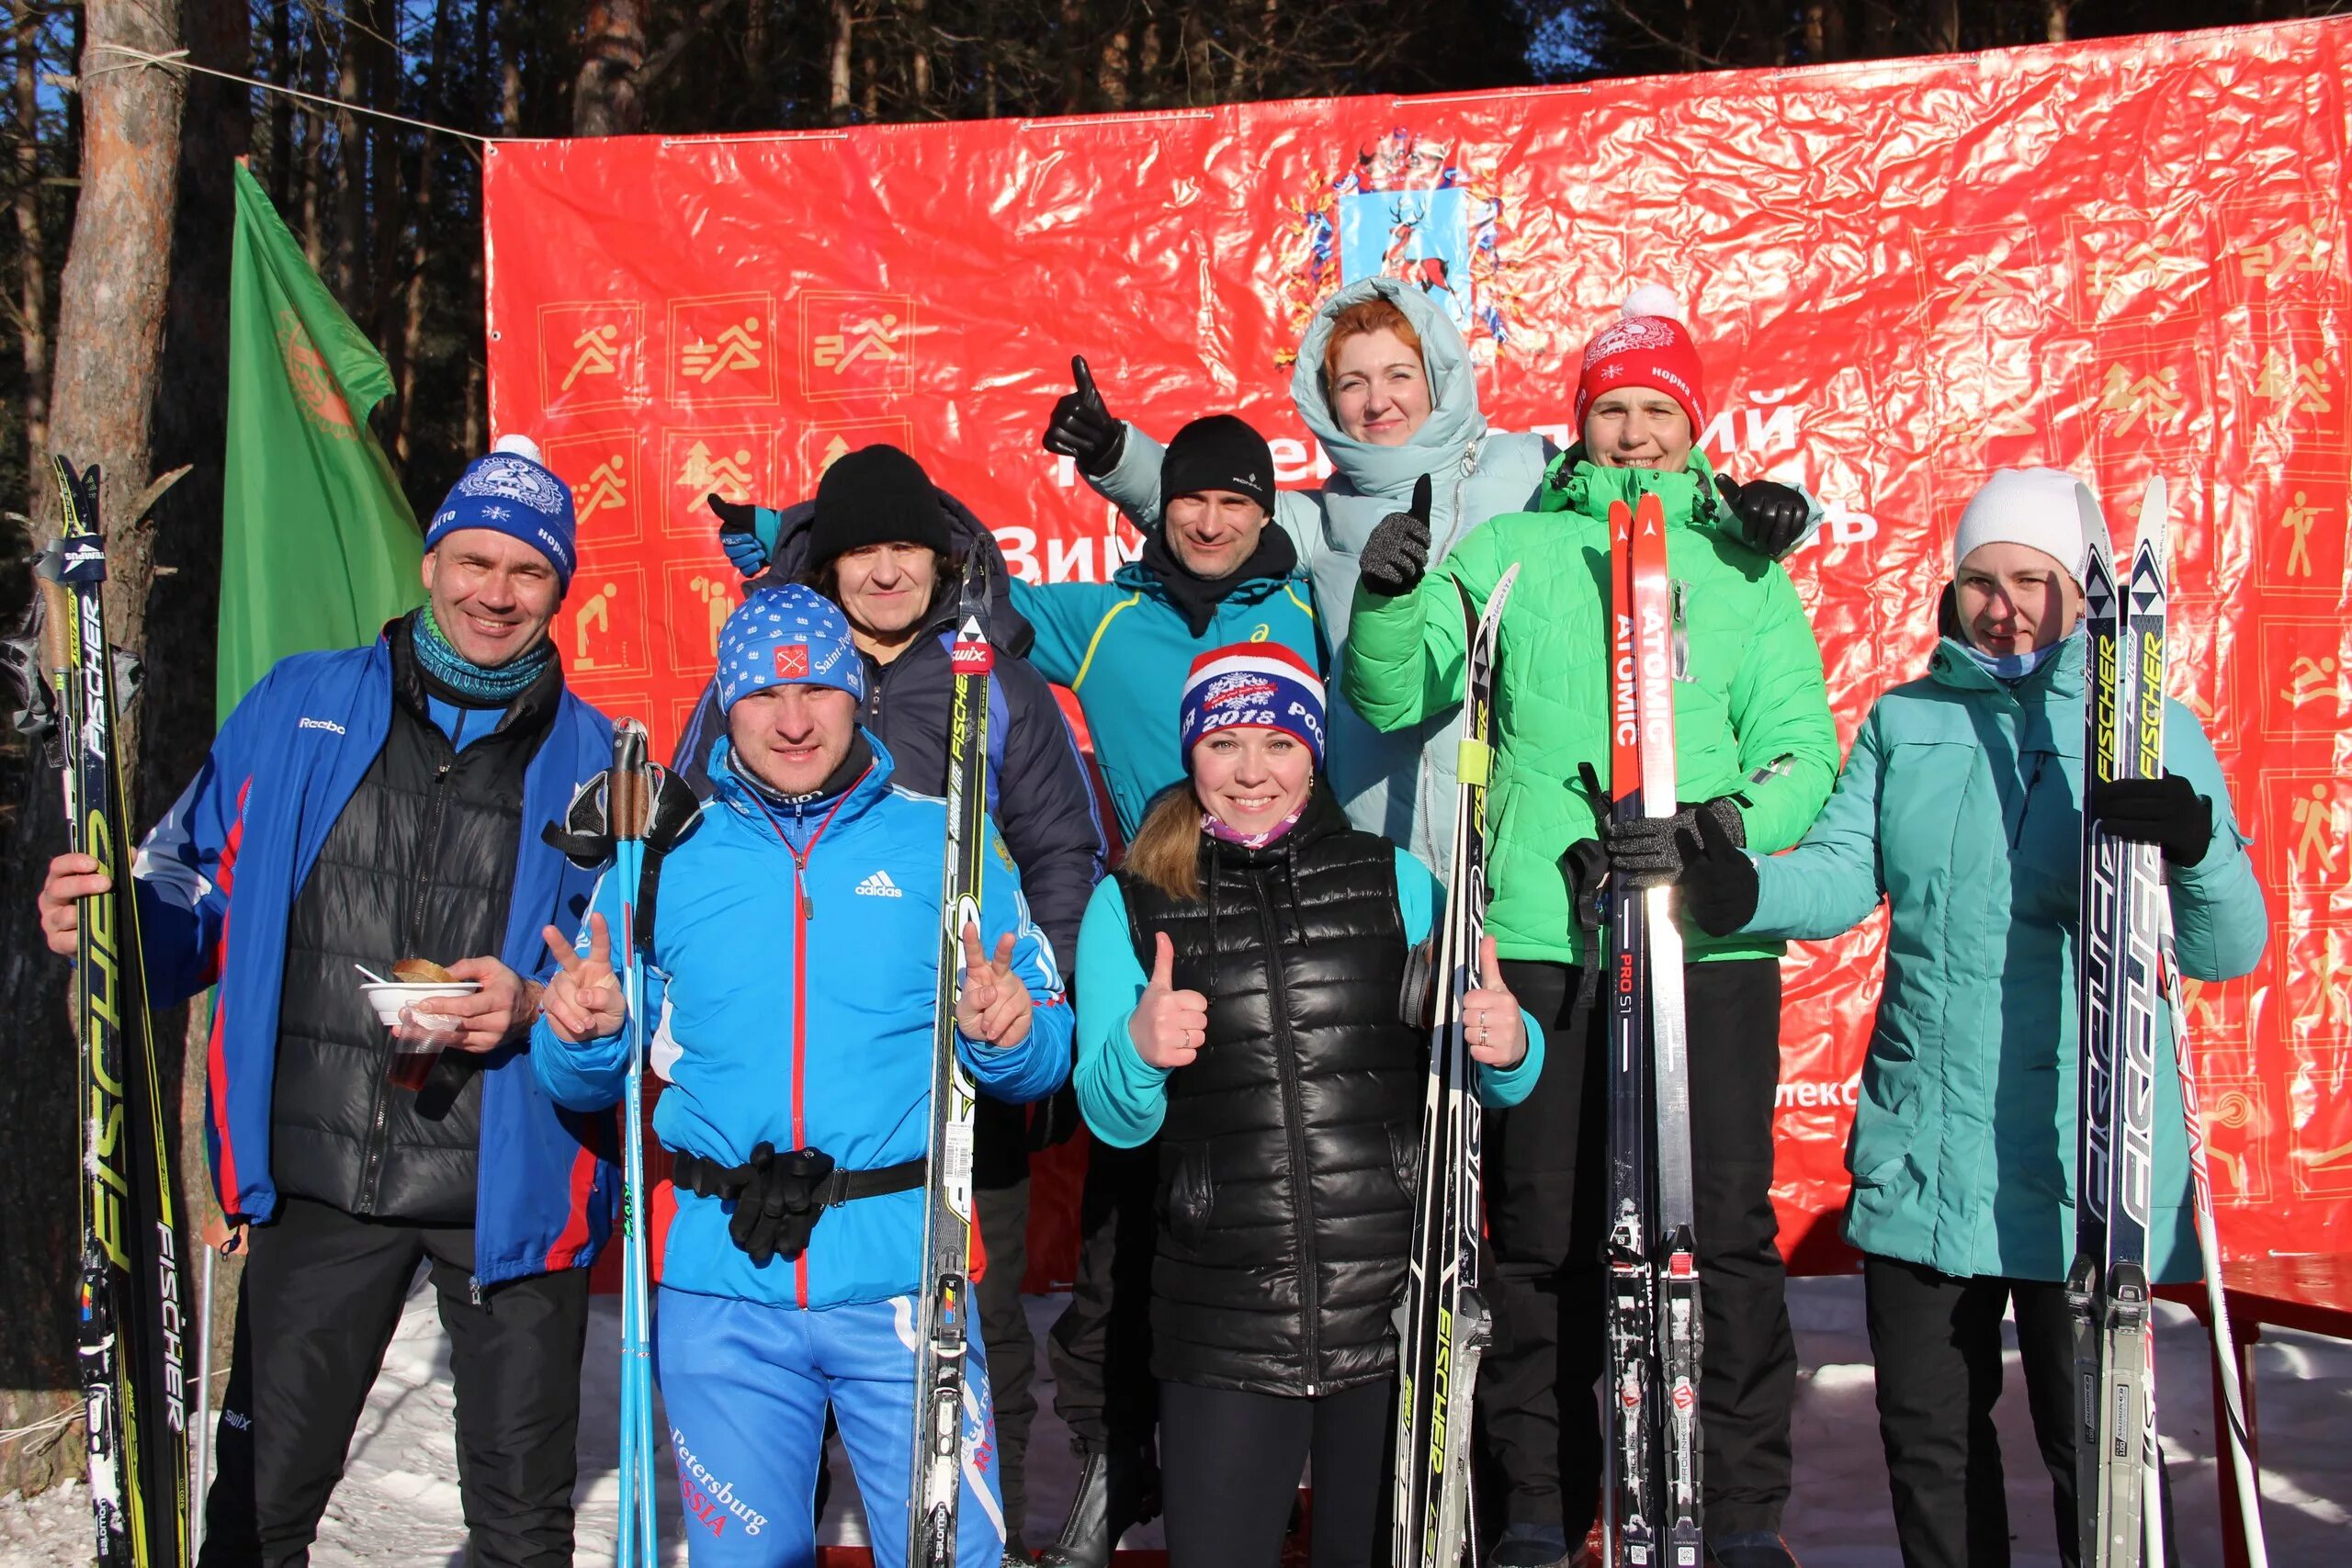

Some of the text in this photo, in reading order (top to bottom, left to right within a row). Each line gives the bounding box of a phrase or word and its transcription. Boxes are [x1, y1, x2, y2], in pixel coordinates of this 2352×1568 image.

[1652, 367, 1690, 397] норма
[82, 595, 107, 761] FISCHER
[952, 673, 968, 762] FISCHE
[1202, 709, 1276, 733] 2018
[1617, 613, 1638, 747] ATOMIC
[1642, 608, 1670, 745] ATOMIC
[2098, 634, 2115, 784] FISCHER
[2140, 631, 2162, 780] FISCHER
[854, 885, 902, 897] adidas
[1620, 953, 1633, 1013] PRO S1
[156, 1221, 186, 1434] FISCHER
[1430, 1306, 1452, 1473] FISCHER
[98, 1497, 109, 1556] salomon
[677, 1464, 727, 1539] SSIA
[934, 1502, 945, 1560] salomon
